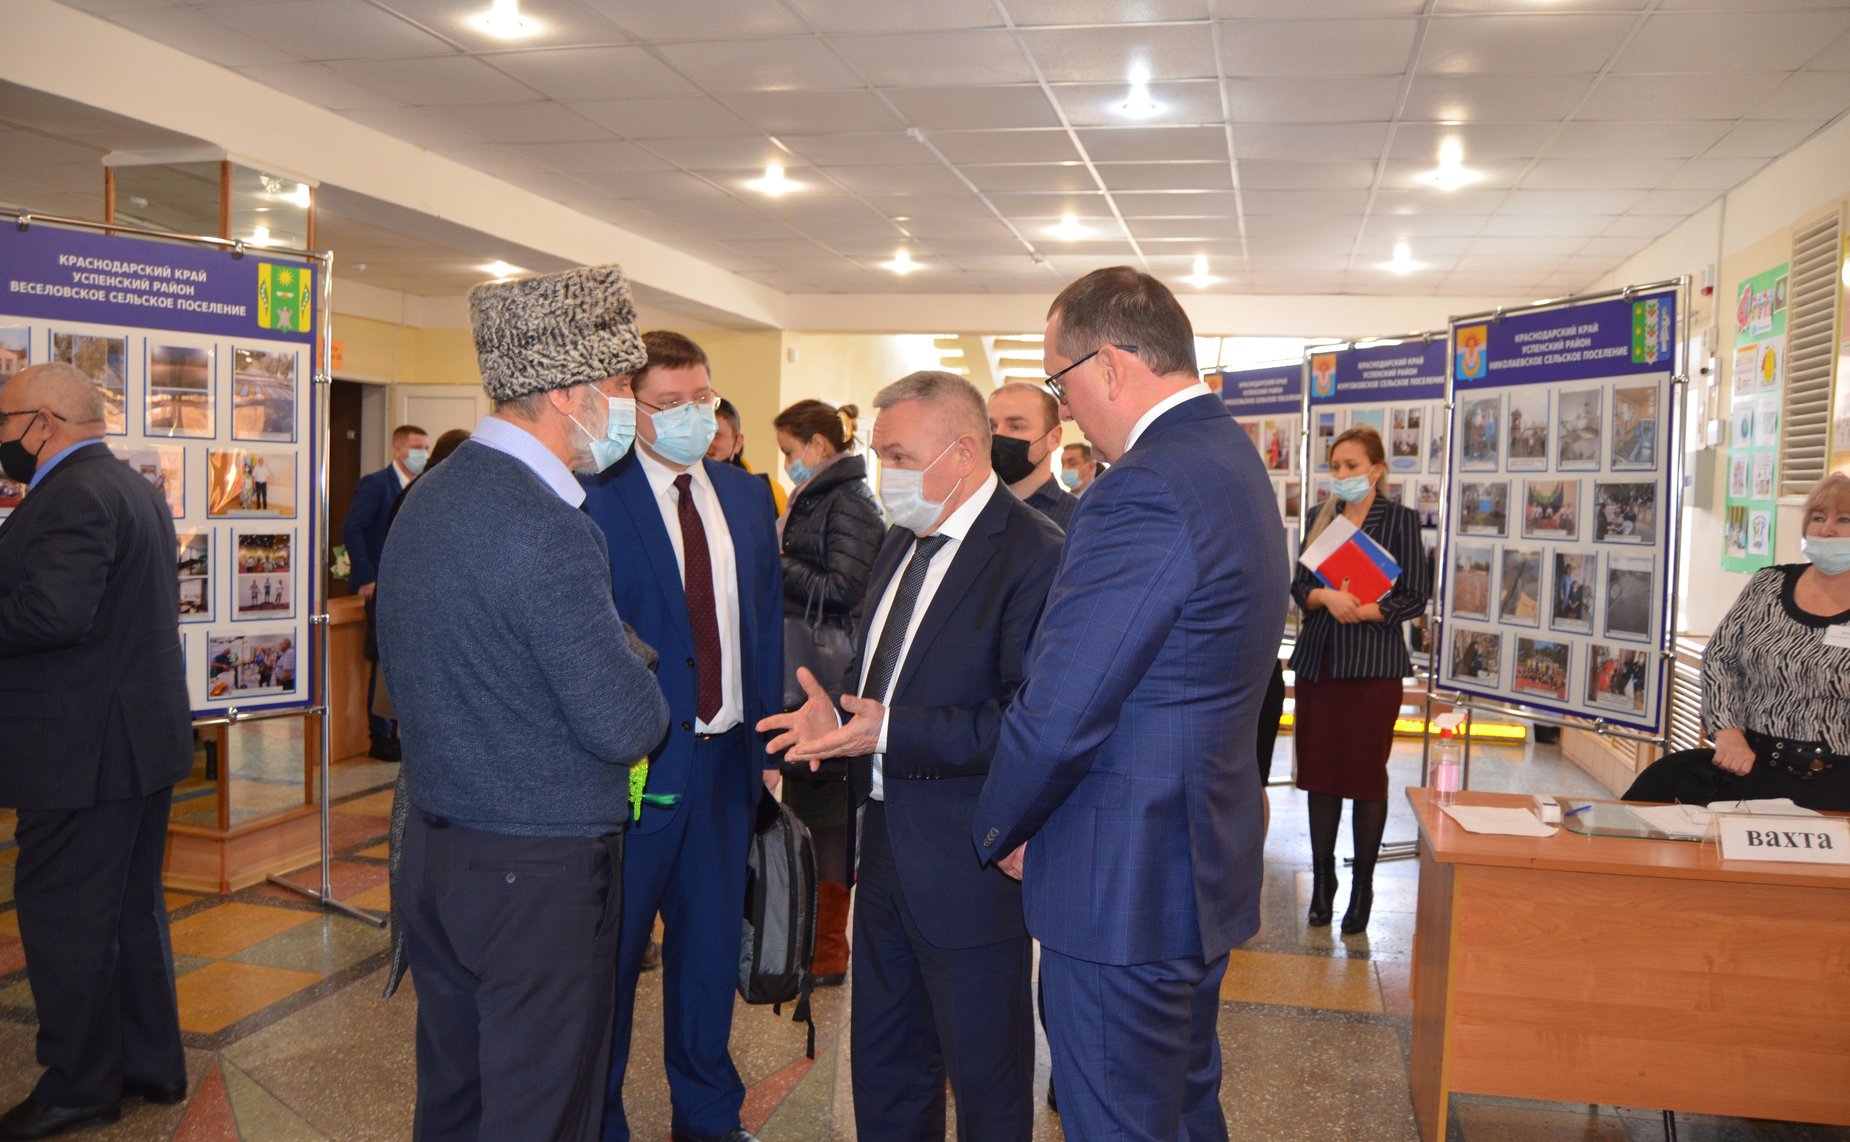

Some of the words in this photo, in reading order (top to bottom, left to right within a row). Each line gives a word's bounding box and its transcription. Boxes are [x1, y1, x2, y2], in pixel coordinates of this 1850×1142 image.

[59, 254, 171, 278] КРАСНОДАРСКИЙ
[174, 268, 207, 282] КРАЙ
[72, 271, 149, 290] УСПЕНСКИЙ
[153, 280, 195, 296] РАЙОН
[10, 280, 106, 301] ВЕСЕЛОВСКОЕ
[109, 292, 174, 309] СЕЛЬСКОЕ
[177, 299, 247, 316] ПОСЕЛЕНИЕ
[1514, 325, 1577, 343] КРАСНОДАРСКИЙ
[1578, 322, 1599, 334] КРАЙ
[1522, 340, 1564, 354] УСПЕНСКИЙ
[1565, 338, 1591, 349] РАЙОН
[1488, 356, 1543, 370] НИКОЛАЕВСКОЕ
[1544, 352, 1581, 364] СЕЛЬСКОЕ
[1583, 347, 1628, 360] ПОСЕЛЕНИЕ
